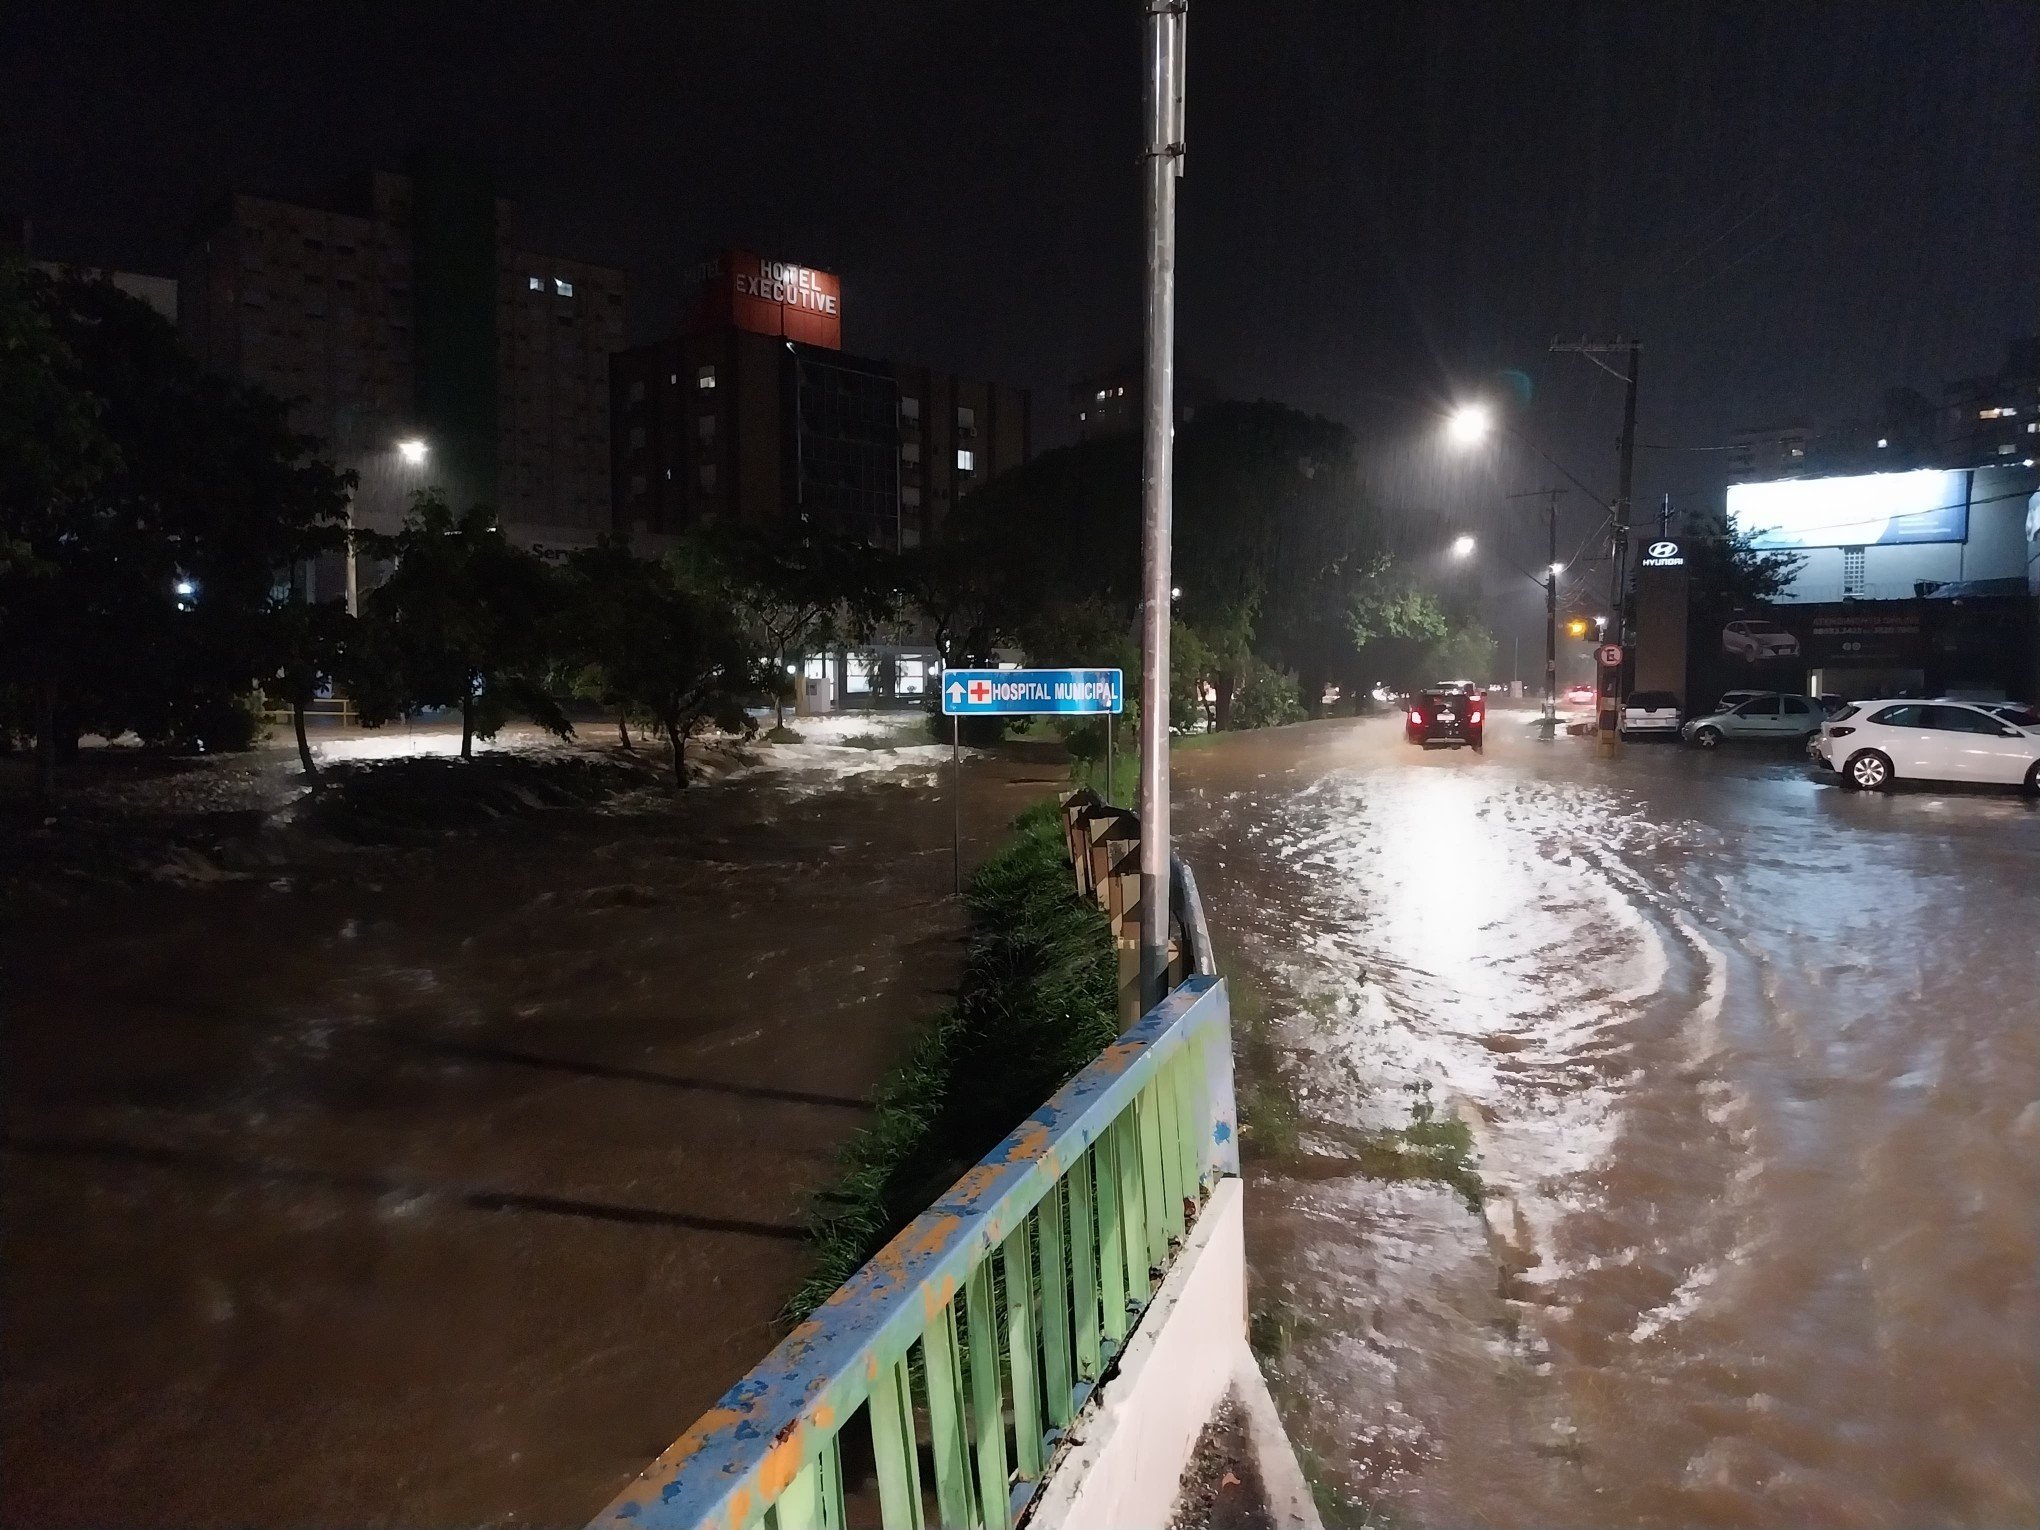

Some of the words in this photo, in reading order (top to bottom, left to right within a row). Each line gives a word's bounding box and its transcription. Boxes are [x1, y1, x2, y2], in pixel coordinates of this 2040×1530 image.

[760, 259, 821, 291] HOTEL
[736, 274, 837, 314] EXECUTIVE
[1642, 558, 1683, 567] HYUNDAI
[1606, 648, 1615, 661] E
[993, 682, 1051, 701] HOSPITAL
[1055, 682, 1118, 700] MUNICIPAL
